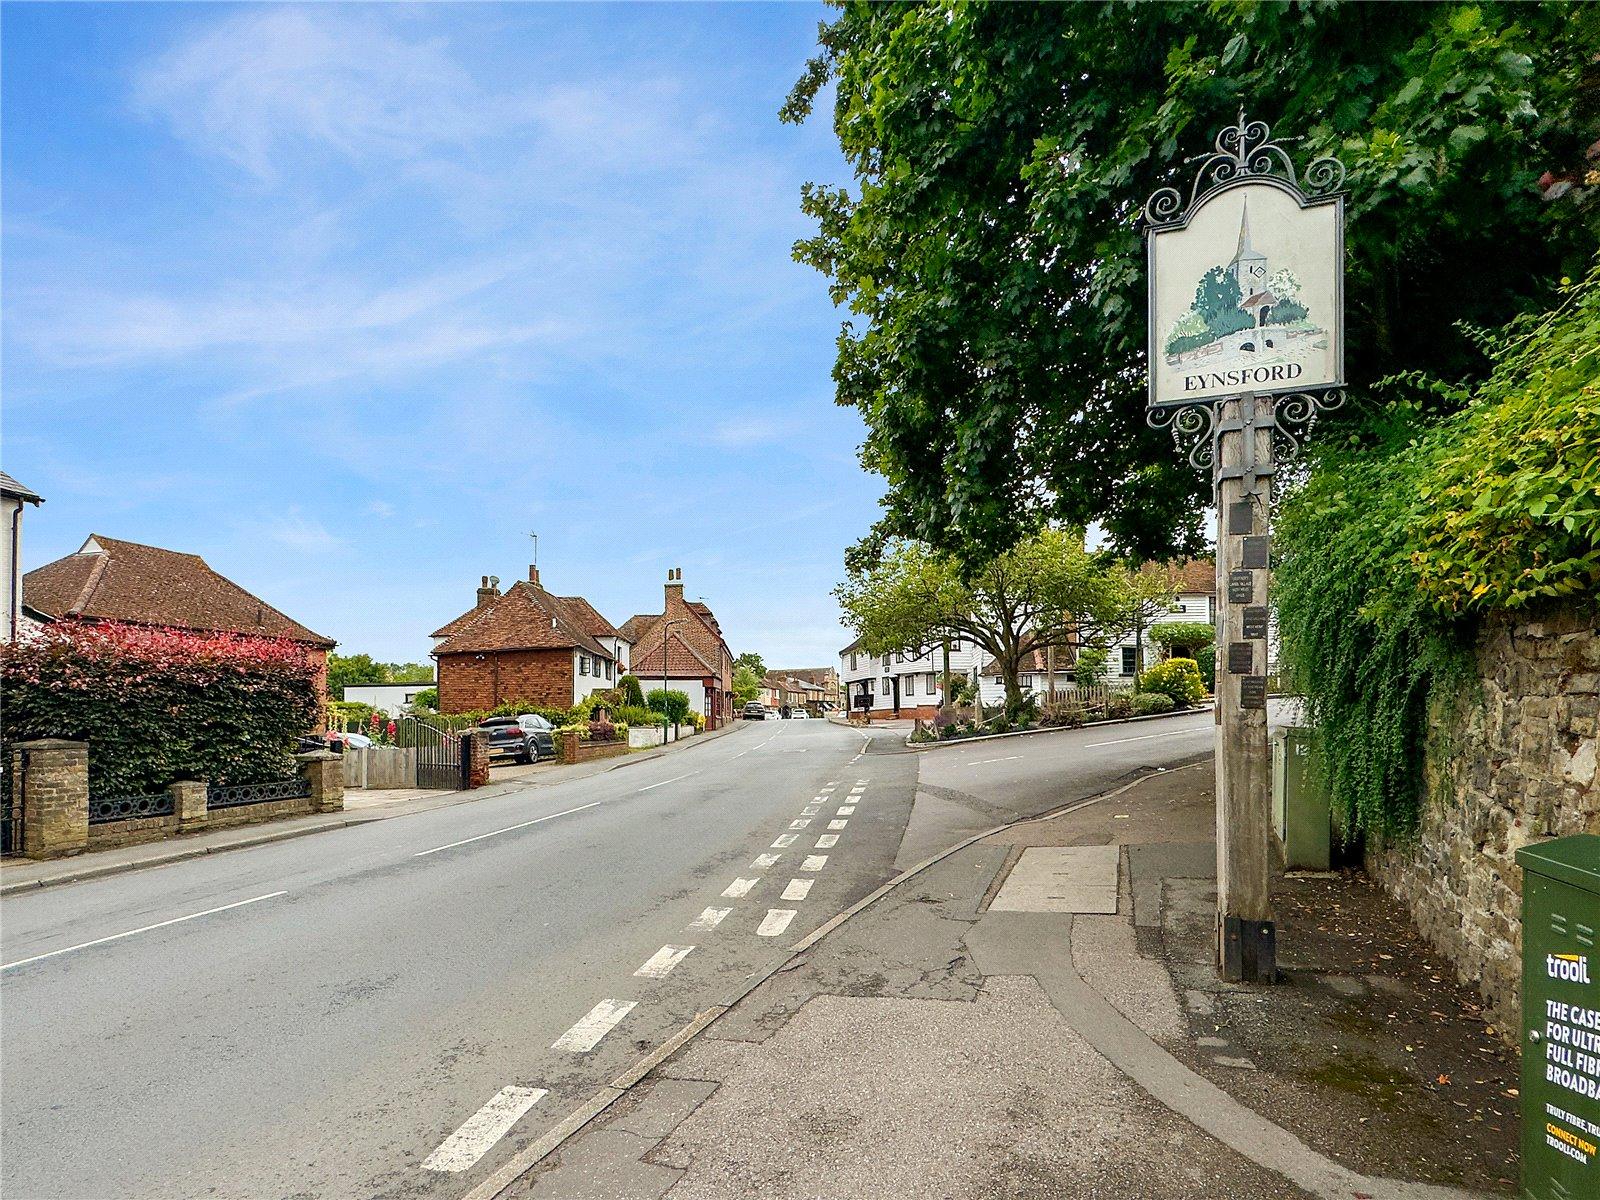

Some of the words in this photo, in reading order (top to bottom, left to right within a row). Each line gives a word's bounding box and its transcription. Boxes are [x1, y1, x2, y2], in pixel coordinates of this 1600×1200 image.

[1184, 363, 1303, 391] EYNSFORD
[1546, 953, 1591, 984] trooli
[1546, 1000, 1569, 1022] THE
[1570, 1006, 1600, 1031] CASE
[1546, 1021, 1570, 1044] FOR
[1546, 1042, 1573, 1068] FULL
[1546, 1103, 1566, 1120] TRULY
[1546, 1122, 1578, 1147] CONNECT
[1578, 1139, 1597, 1156] NOW
